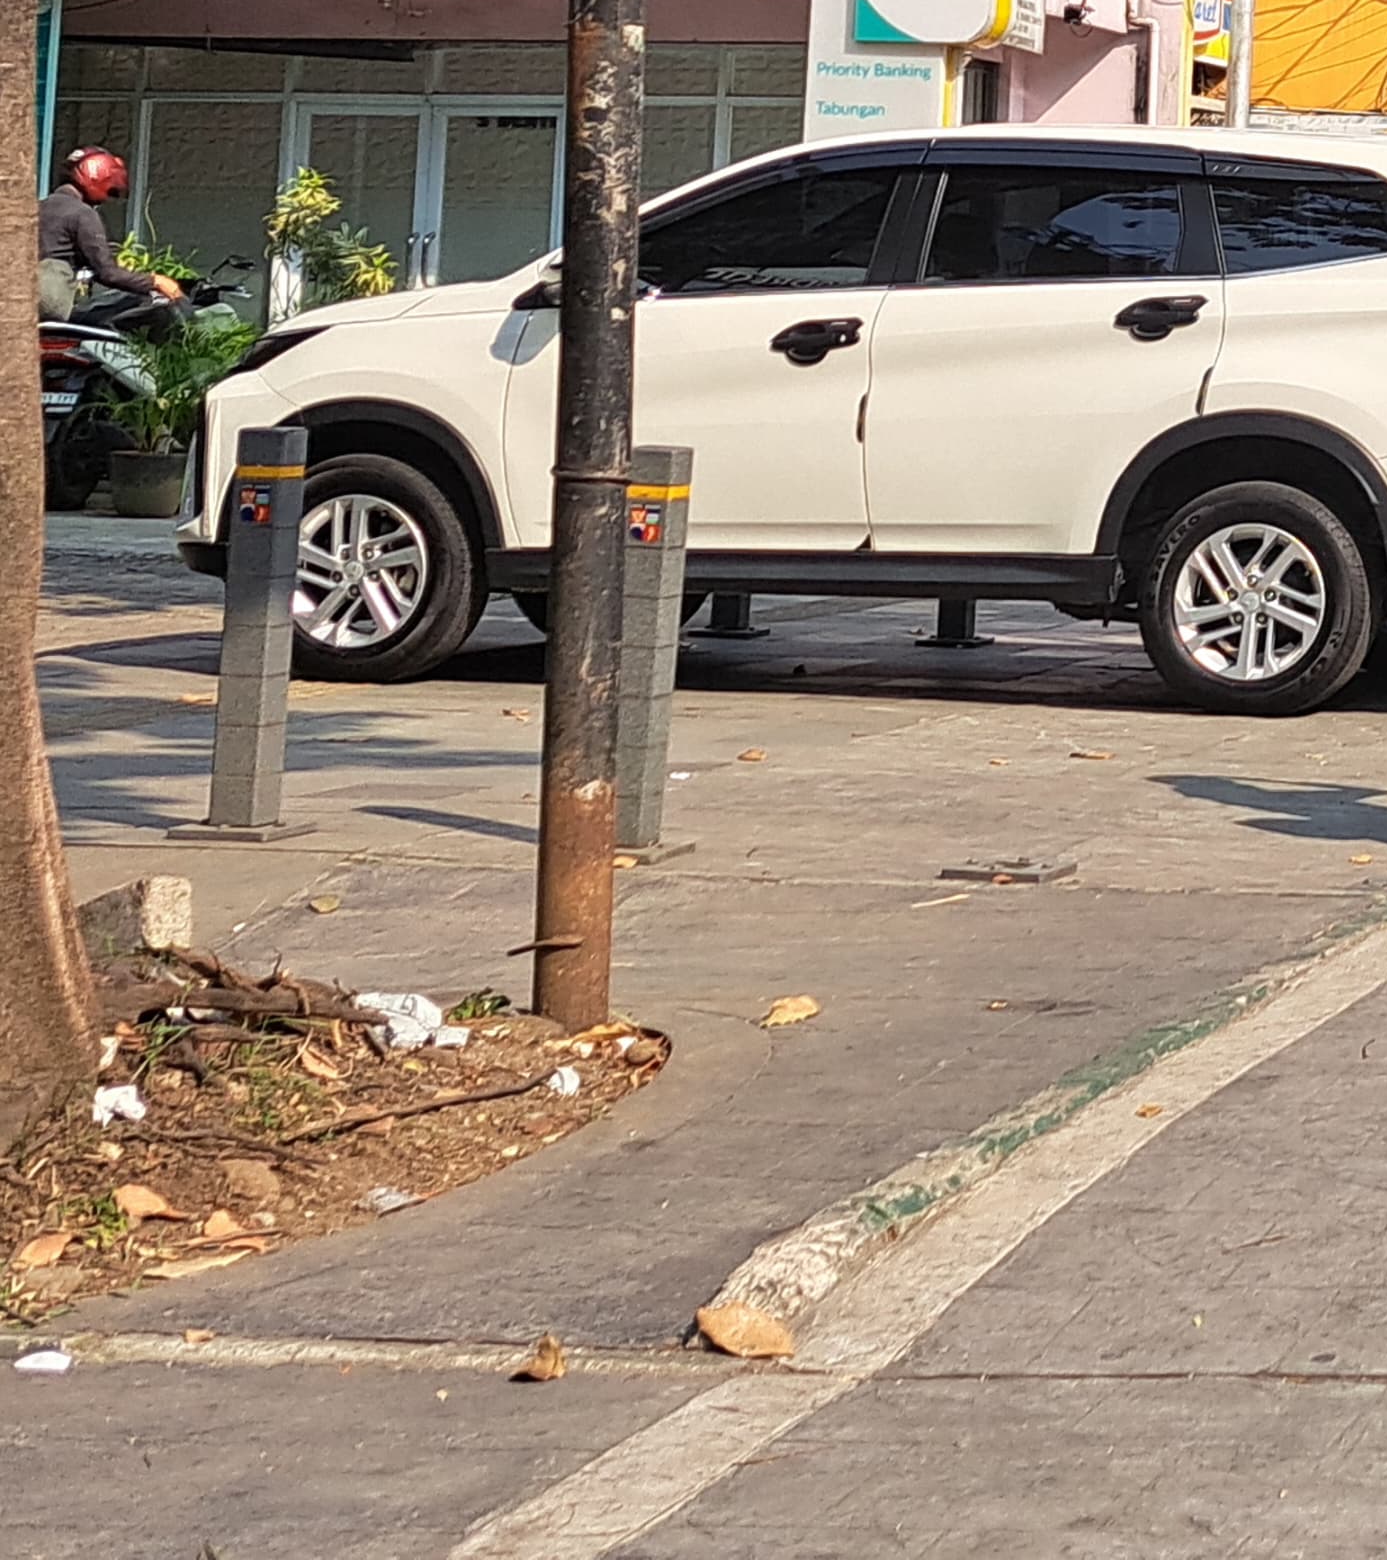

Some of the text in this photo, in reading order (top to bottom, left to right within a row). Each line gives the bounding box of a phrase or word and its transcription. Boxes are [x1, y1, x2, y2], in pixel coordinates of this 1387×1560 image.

[816, 61, 932, 81] Priority Banking
[815, 100, 886, 119] Tabungan
